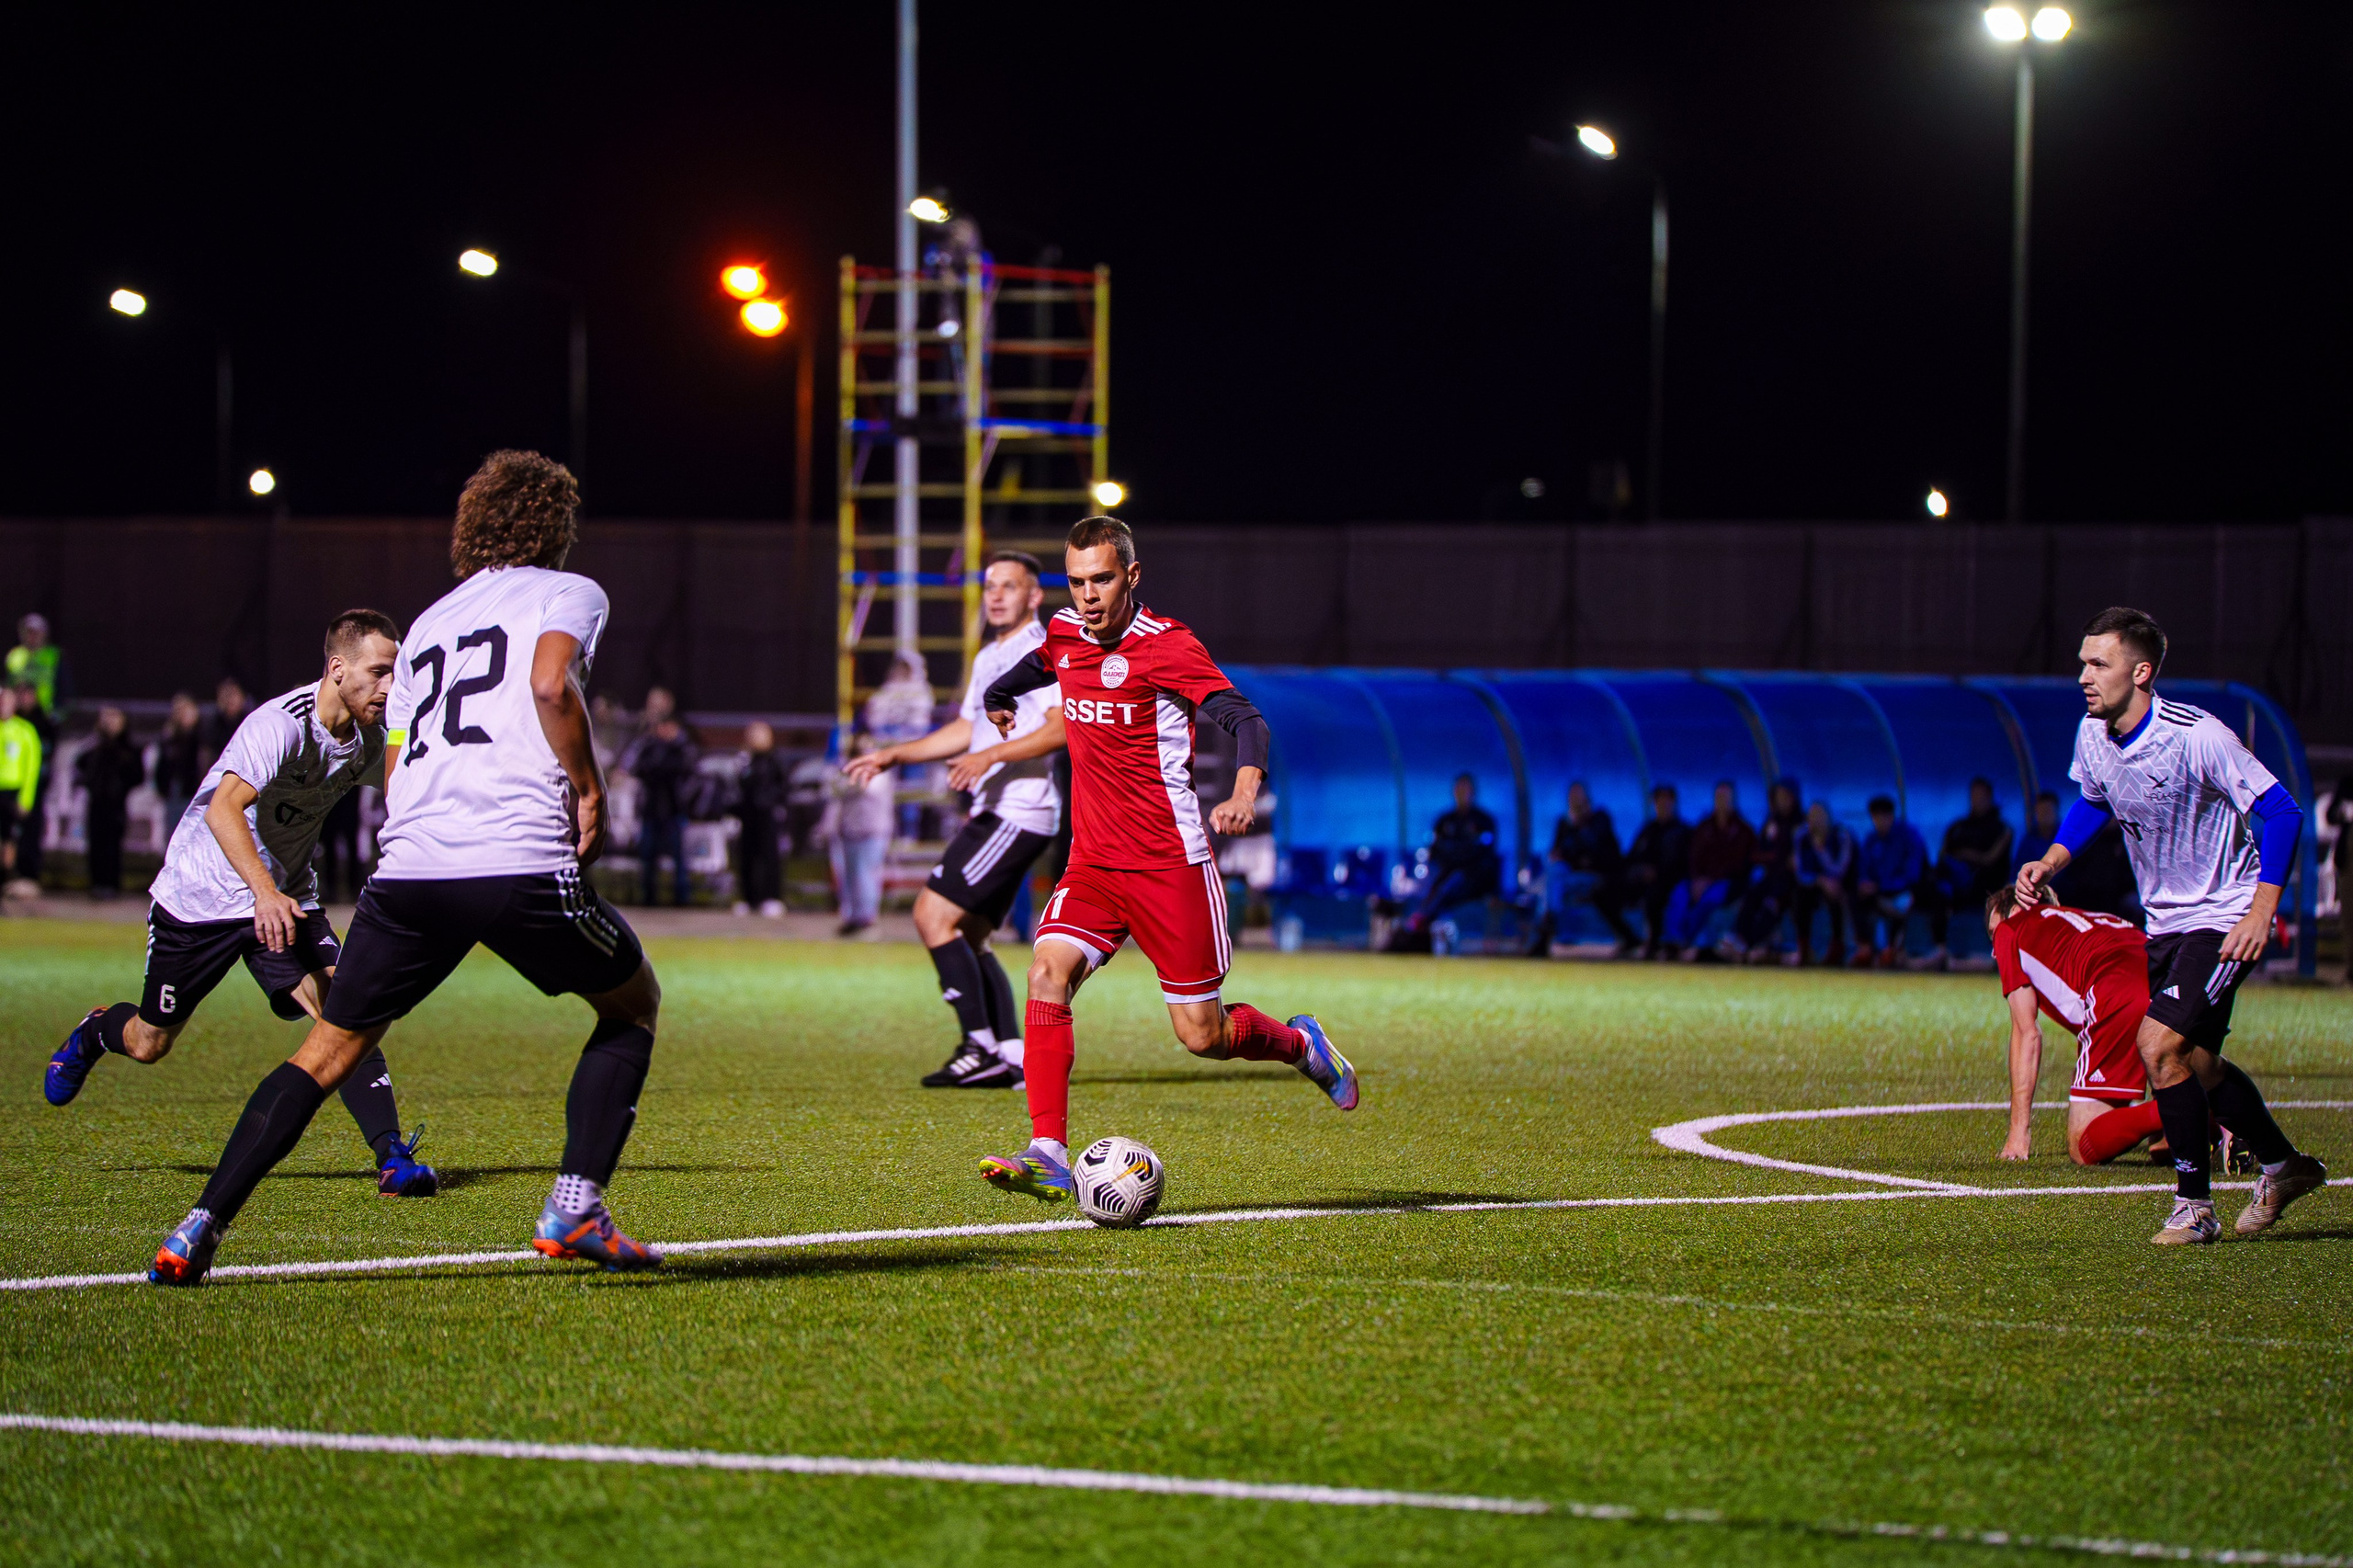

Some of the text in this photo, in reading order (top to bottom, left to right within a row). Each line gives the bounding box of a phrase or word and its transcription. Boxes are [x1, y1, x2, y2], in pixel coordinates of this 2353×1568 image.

[404, 624, 508, 767] 22
[1063, 697, 1139, 725] SSET
[159, 983, 176, 1014] 6
